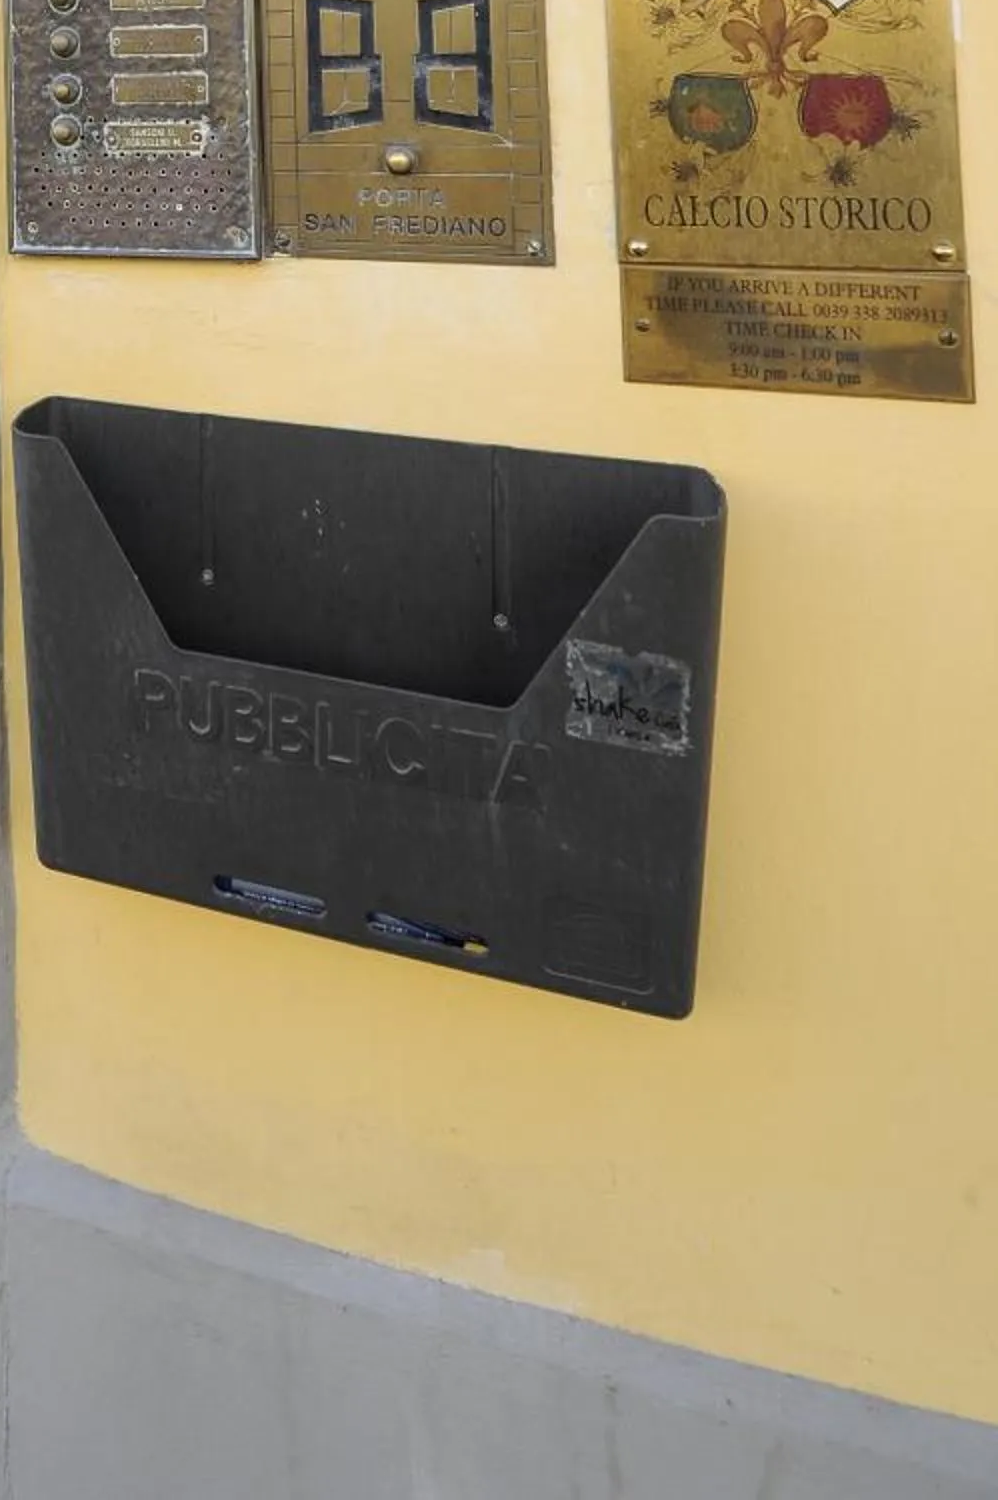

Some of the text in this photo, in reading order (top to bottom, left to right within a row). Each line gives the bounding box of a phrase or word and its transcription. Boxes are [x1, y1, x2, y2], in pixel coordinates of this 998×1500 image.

[358, 187, 447, 208] PORTA
[644, 193, 932, 232] CALCIO STORICO
[303, 213, 507, 237] SAN FREDIANO
[688, 277, 722, 292] YOU
[729, 279, 793, 295] ARRIVE
[798, 282, 809, 297] A
[815, 282, 922, 301] DIFFERENT
[645, 296, 690, 313] TIME
[693, 297, 754, 315] PLEASE
[760, 300, 807, 318] CALL
[814, 303, 849, 318] 0039
[726, 320, 862, 341] TIME CHECK IN
